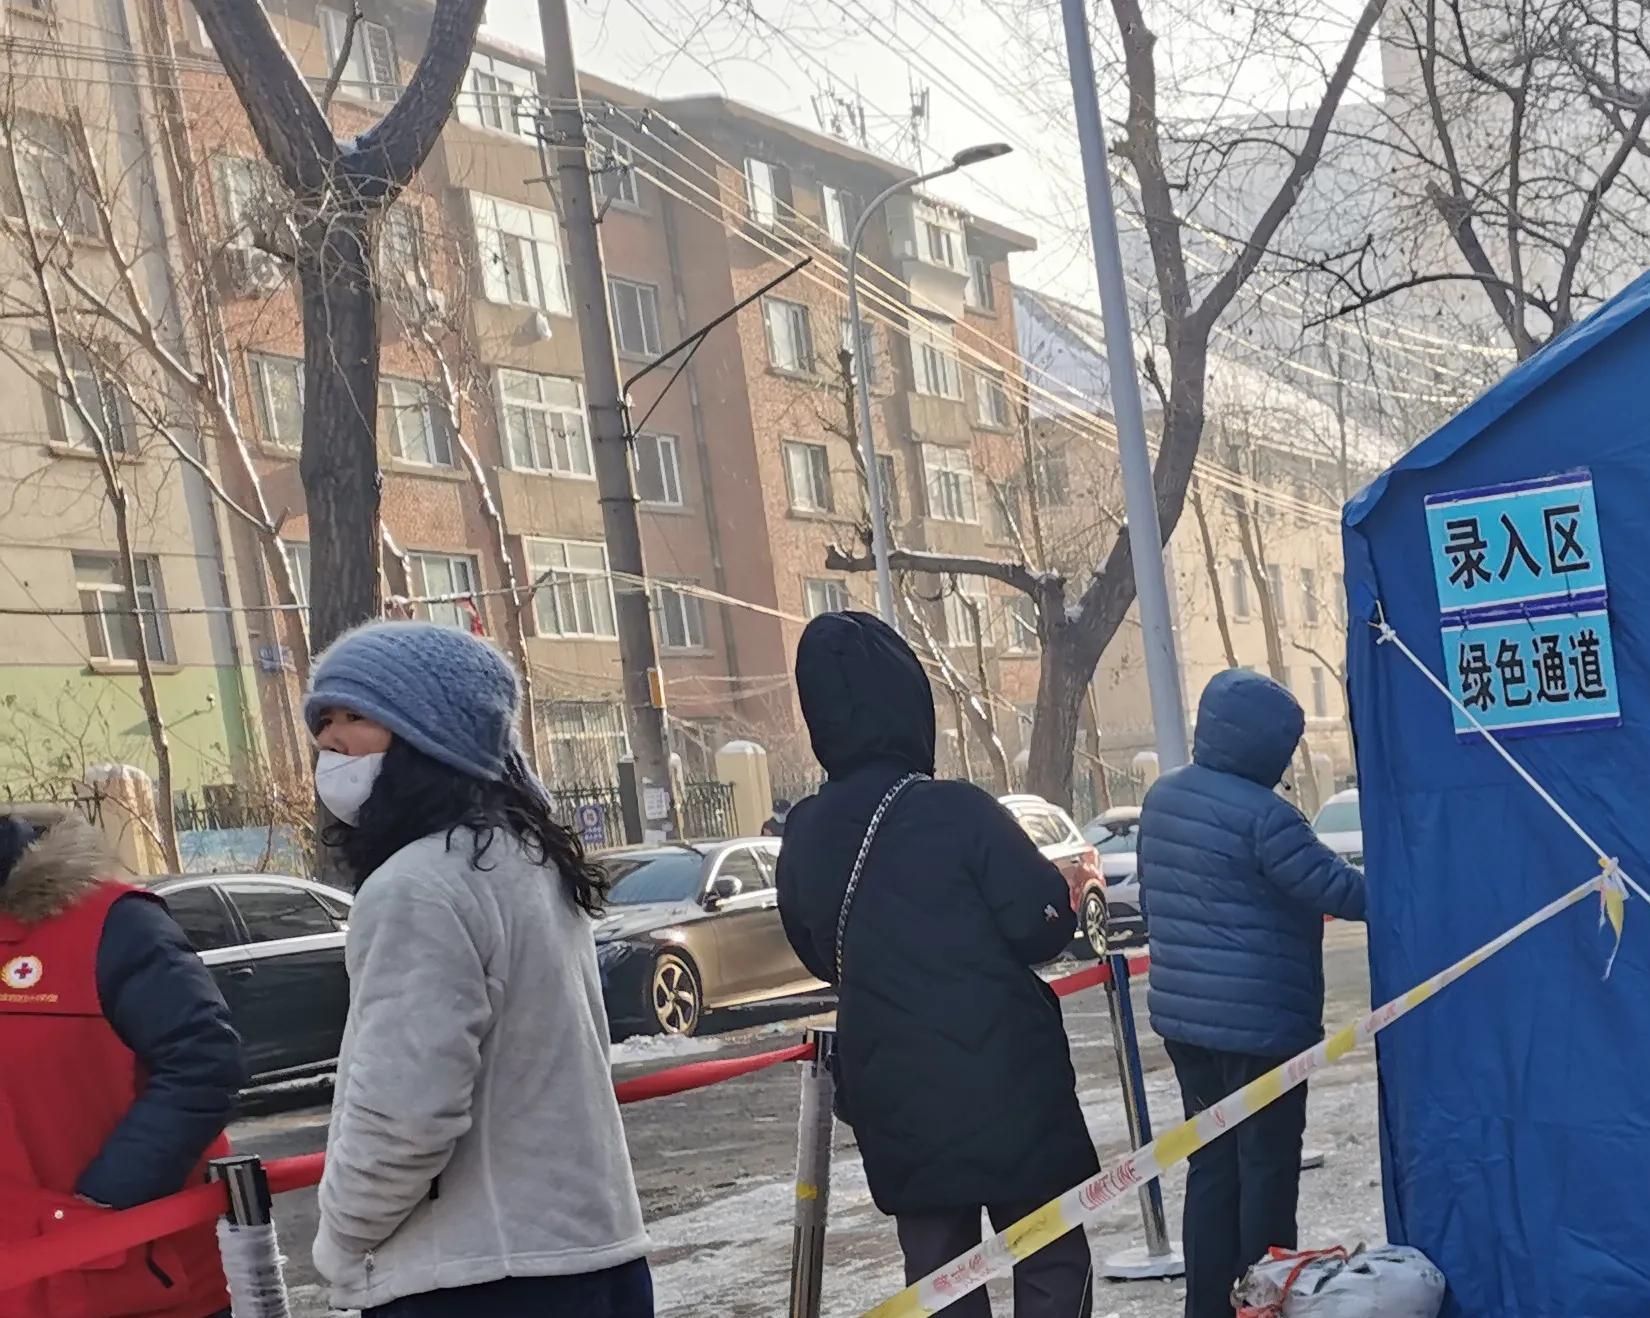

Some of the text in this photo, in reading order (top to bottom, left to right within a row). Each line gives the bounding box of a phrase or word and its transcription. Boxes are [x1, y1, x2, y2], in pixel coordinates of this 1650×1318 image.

[1445, 504, 1591, 589] 录入区
[1459, 629, 1607, 712] 绿色通道
